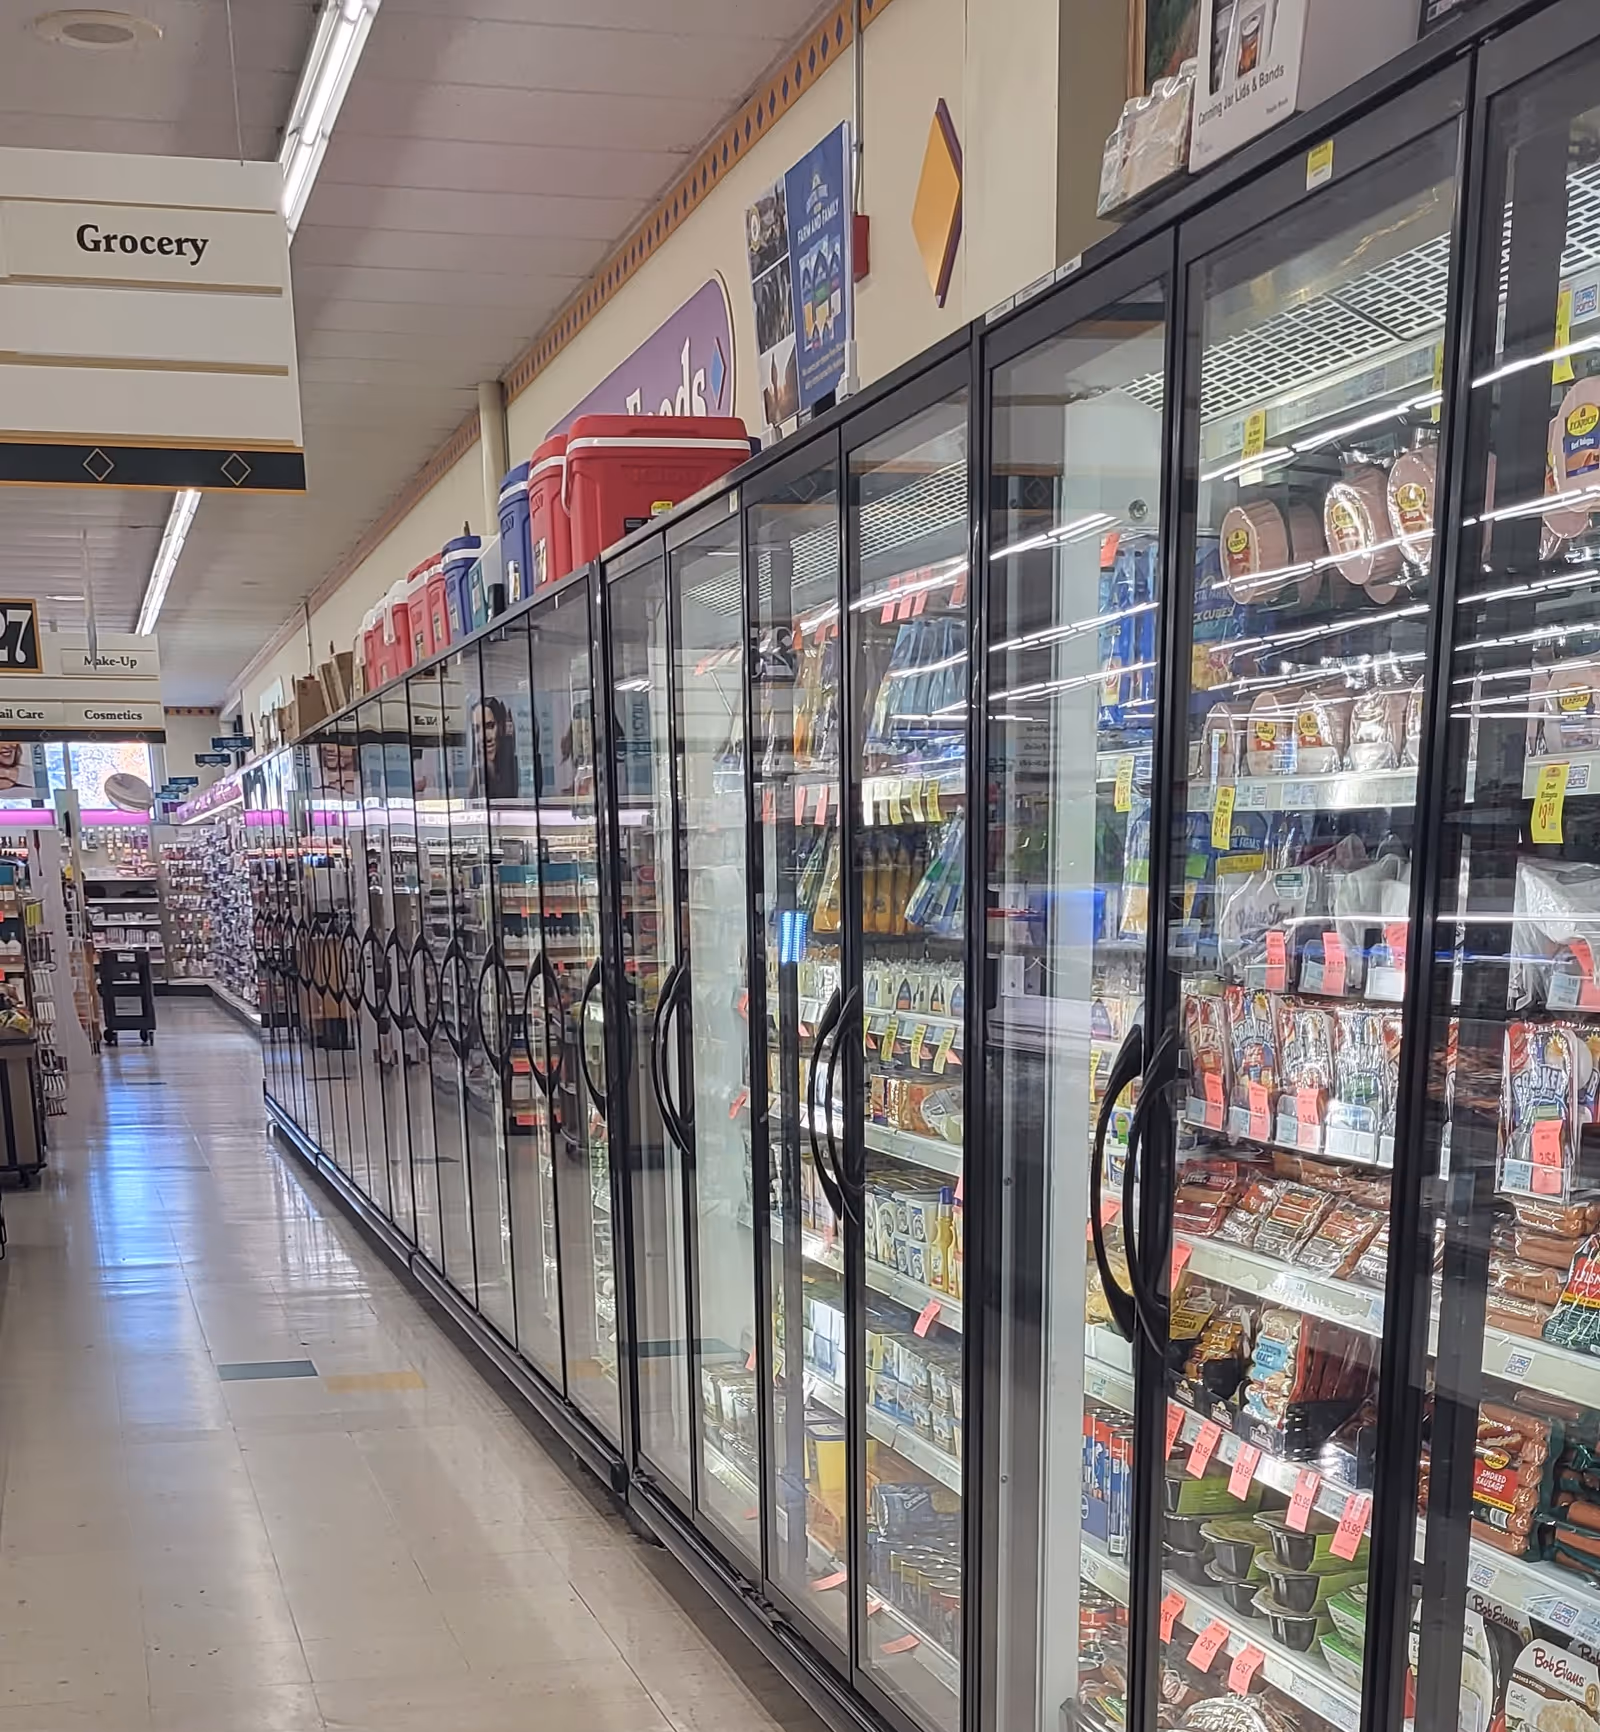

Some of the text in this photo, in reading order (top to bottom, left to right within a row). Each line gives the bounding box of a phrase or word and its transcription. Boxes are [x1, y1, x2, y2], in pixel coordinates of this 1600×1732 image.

[1198, 64, 1285, 127] Canning Jar Lids & Bands
[821, 197, 840, 227] FAMILY
[76, 224, 209, 266] Grocery
[1202, 607, 1234, 621] CUBES
[84, 656, 137, 669] Make-Up
[0, 708, 45, 719] ail Care
[84, 709, 143, 721] Cosmetics
[1476, 1476, 1505, 1493] SAUSAGE
[1480, 1469, 1507, 1484] SMOKED
[1340, 1519, 1361, 1536] $3.99
[1472, 1594, 1492, 1617] Bob
[1492, 1605, 1520, 1632] Evans
[1532, 1647, 1586, 1687] Bob Evans
[1510, 1689, 1528, 1705] Garlic
